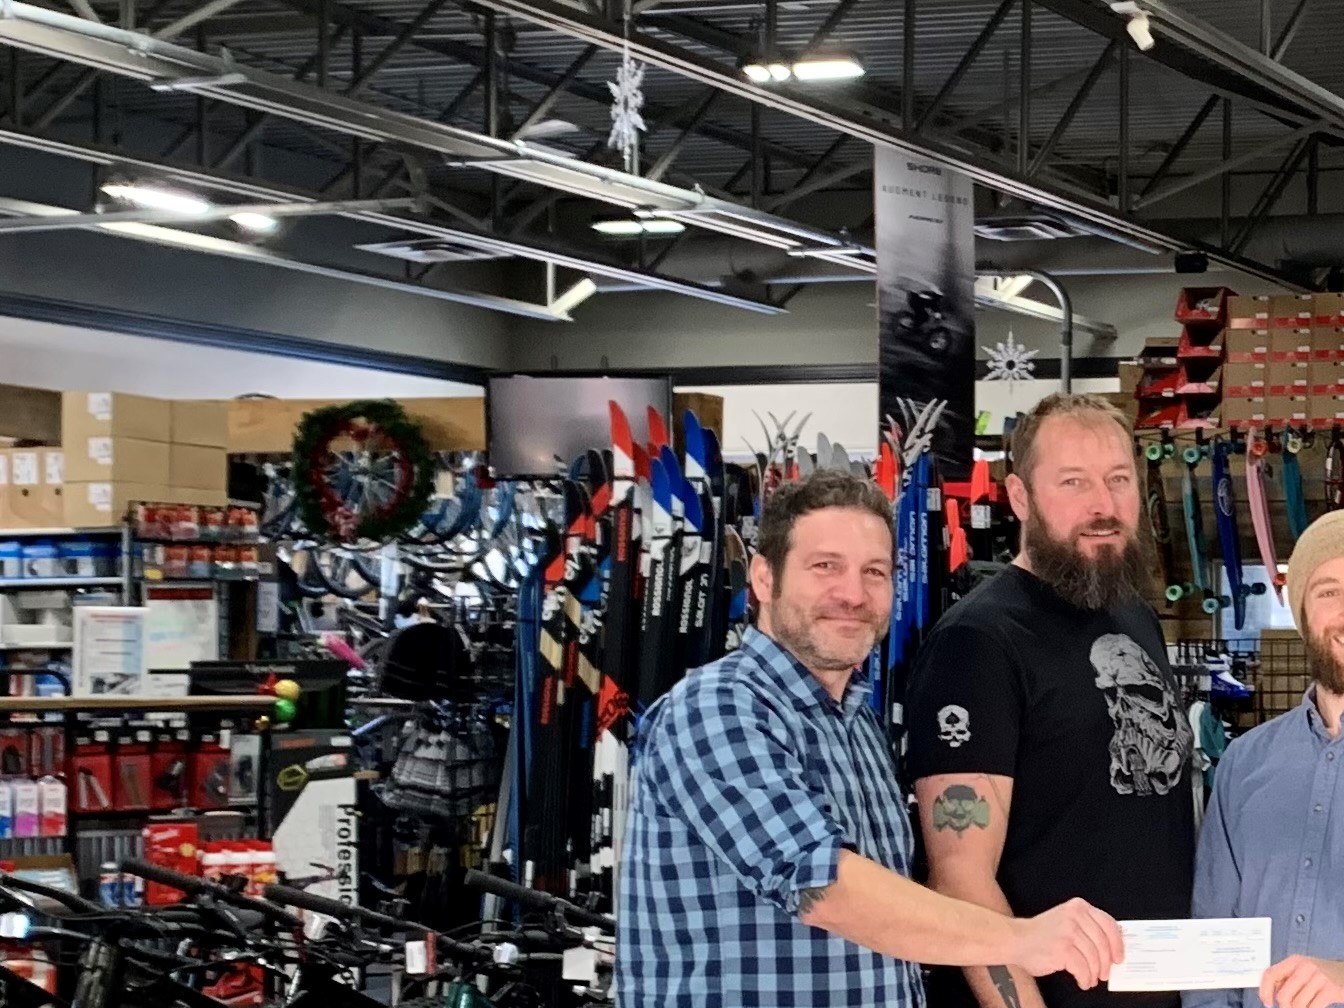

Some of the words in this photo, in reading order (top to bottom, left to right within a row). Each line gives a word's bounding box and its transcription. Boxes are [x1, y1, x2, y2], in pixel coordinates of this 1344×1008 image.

[652, 562, 665, 617] ROSSIGNOL
[679, 578, 694, 634] ROSSIGNOL
[337, 803, 358, 910] Professio
